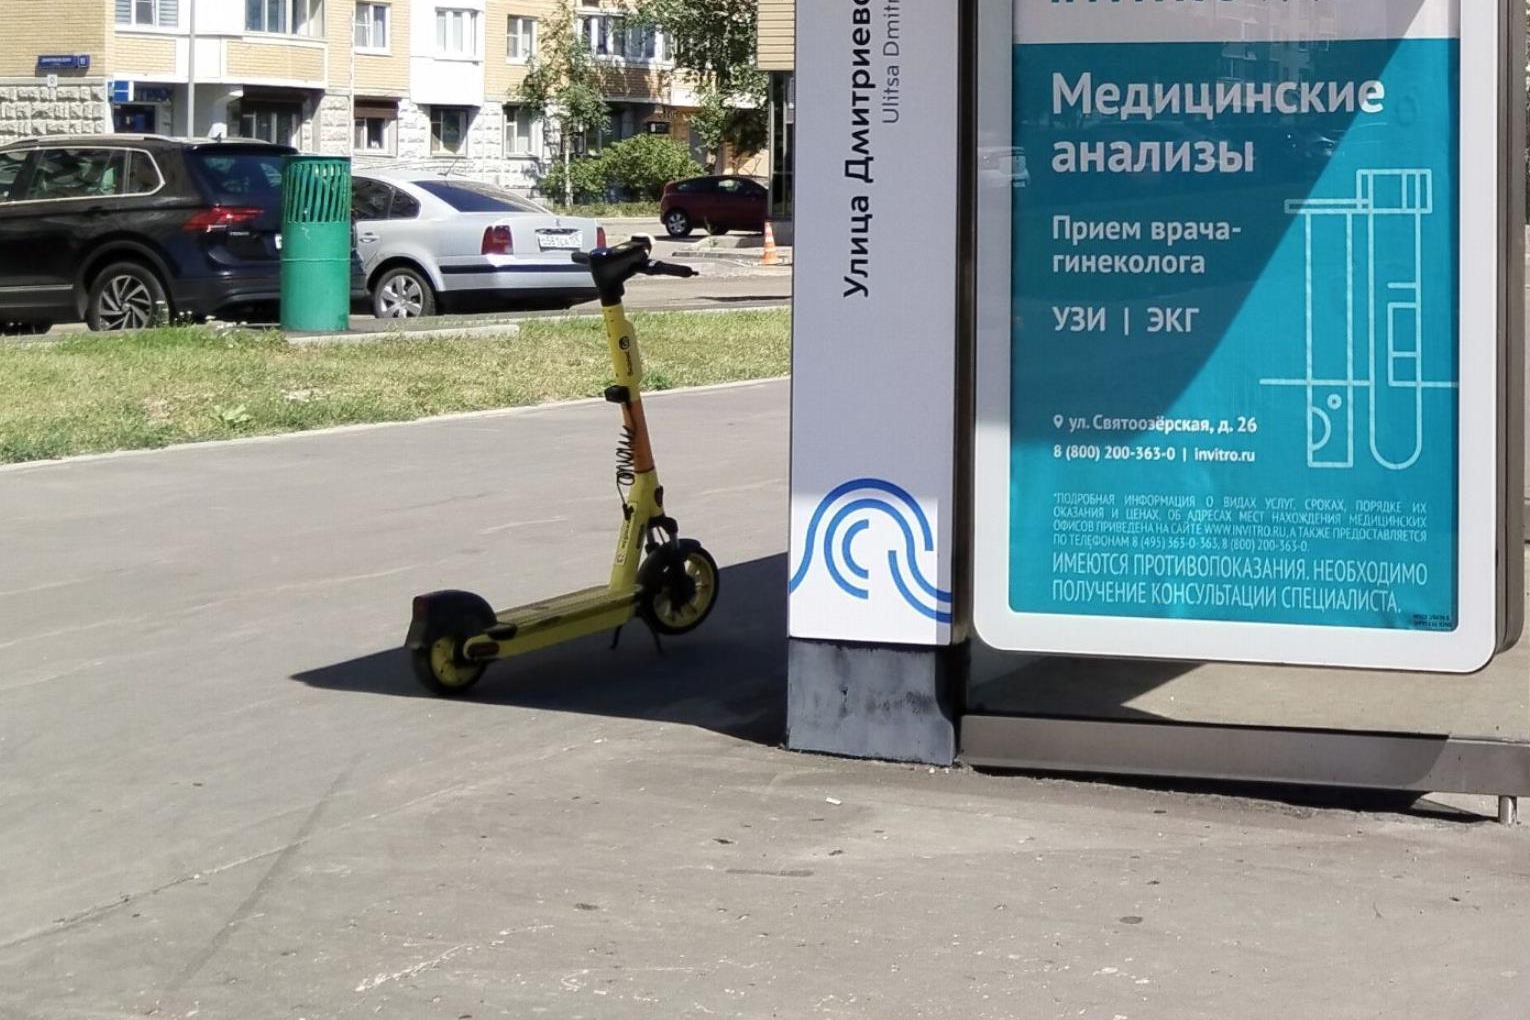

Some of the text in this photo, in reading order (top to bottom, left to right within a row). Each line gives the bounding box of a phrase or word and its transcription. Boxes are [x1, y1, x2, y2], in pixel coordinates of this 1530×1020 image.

[882, 65, 900, 124] Ulitsa
[1052, 72, 1385, 120] Медицинские
[1051, 140, 1254, 173] анализы
[1053, 215, 1241, 246] Прием врача-
[843, 195, 873, 298] Улица
[1053, 254, 1205, 274] гинеколога
[1052, 306, 1106, 332] УЗИ
[1146, 307, 1199, 333] ЭКГ
[1068, 414, 1257, 434] ул. Святоозёрская, д. 26
[1053, 445, 1062, 458] 8
[1066, 444, 1100, 461] (800)
[1104, 445, 1176, 460] 200-363-0
[1194, 447, 1256, 462] invitro.ru
[1053, 506, 1105, 519] ОКАЗАНИЯ
[1111, 507, 1119, 519] И
[1167, 509, 1181, 521] ОБ
[1187, 509, 1232, 522] АДРЕСАХ
[1239, 510, 1264, 523] МЕСТ
[1271, 511, 1341, 525] НАХОЖДЕНИЯ
[1350, 514, 1427, 528] МЕДИЦИНСКИХ
[1124, 494, 1195, 508] ИНФОРМАЦИЯ
[1205, 496, 1213, 508] О
[1223, 496, 1257, 509] ВИДАХ
[1355, 499, 1401, 513] ПОРЯДКЕ
[1412, 501, 1427, 513] ИХ
[1053, 519, 1094, 532] ОФИСОВ
[1096, 520, 1155, 534] ПРИВЕДЕНА
[1155, 522, 1169, 533] НА
[1170, 520, 1201, 535] САЙТЕ
[1298, 526, 1331, 539] ТАКЖЕ
[1332, 527, 1427, 542] ПРЕДОСТАВЛЯЕТСЯ
[1053, 533, 1067, 546] ПО
[1069, 533, 1129, 547] ТЕЛЕФОНАМ
[1131, 536, 1137, 547] 8
[1140, 536, 1165, 550] (495)
[1053, 552, 1428, 586] ИМЕЮТСЯ ПРОТИВОПОКАЗАНИЯ. НЕОБХОДИМО
[1052, 579, 1402, 613] ПОЛУЧЕНИЕ КОНСУЛЬТАЦИИ СПЕЦИАЛИСТА.
